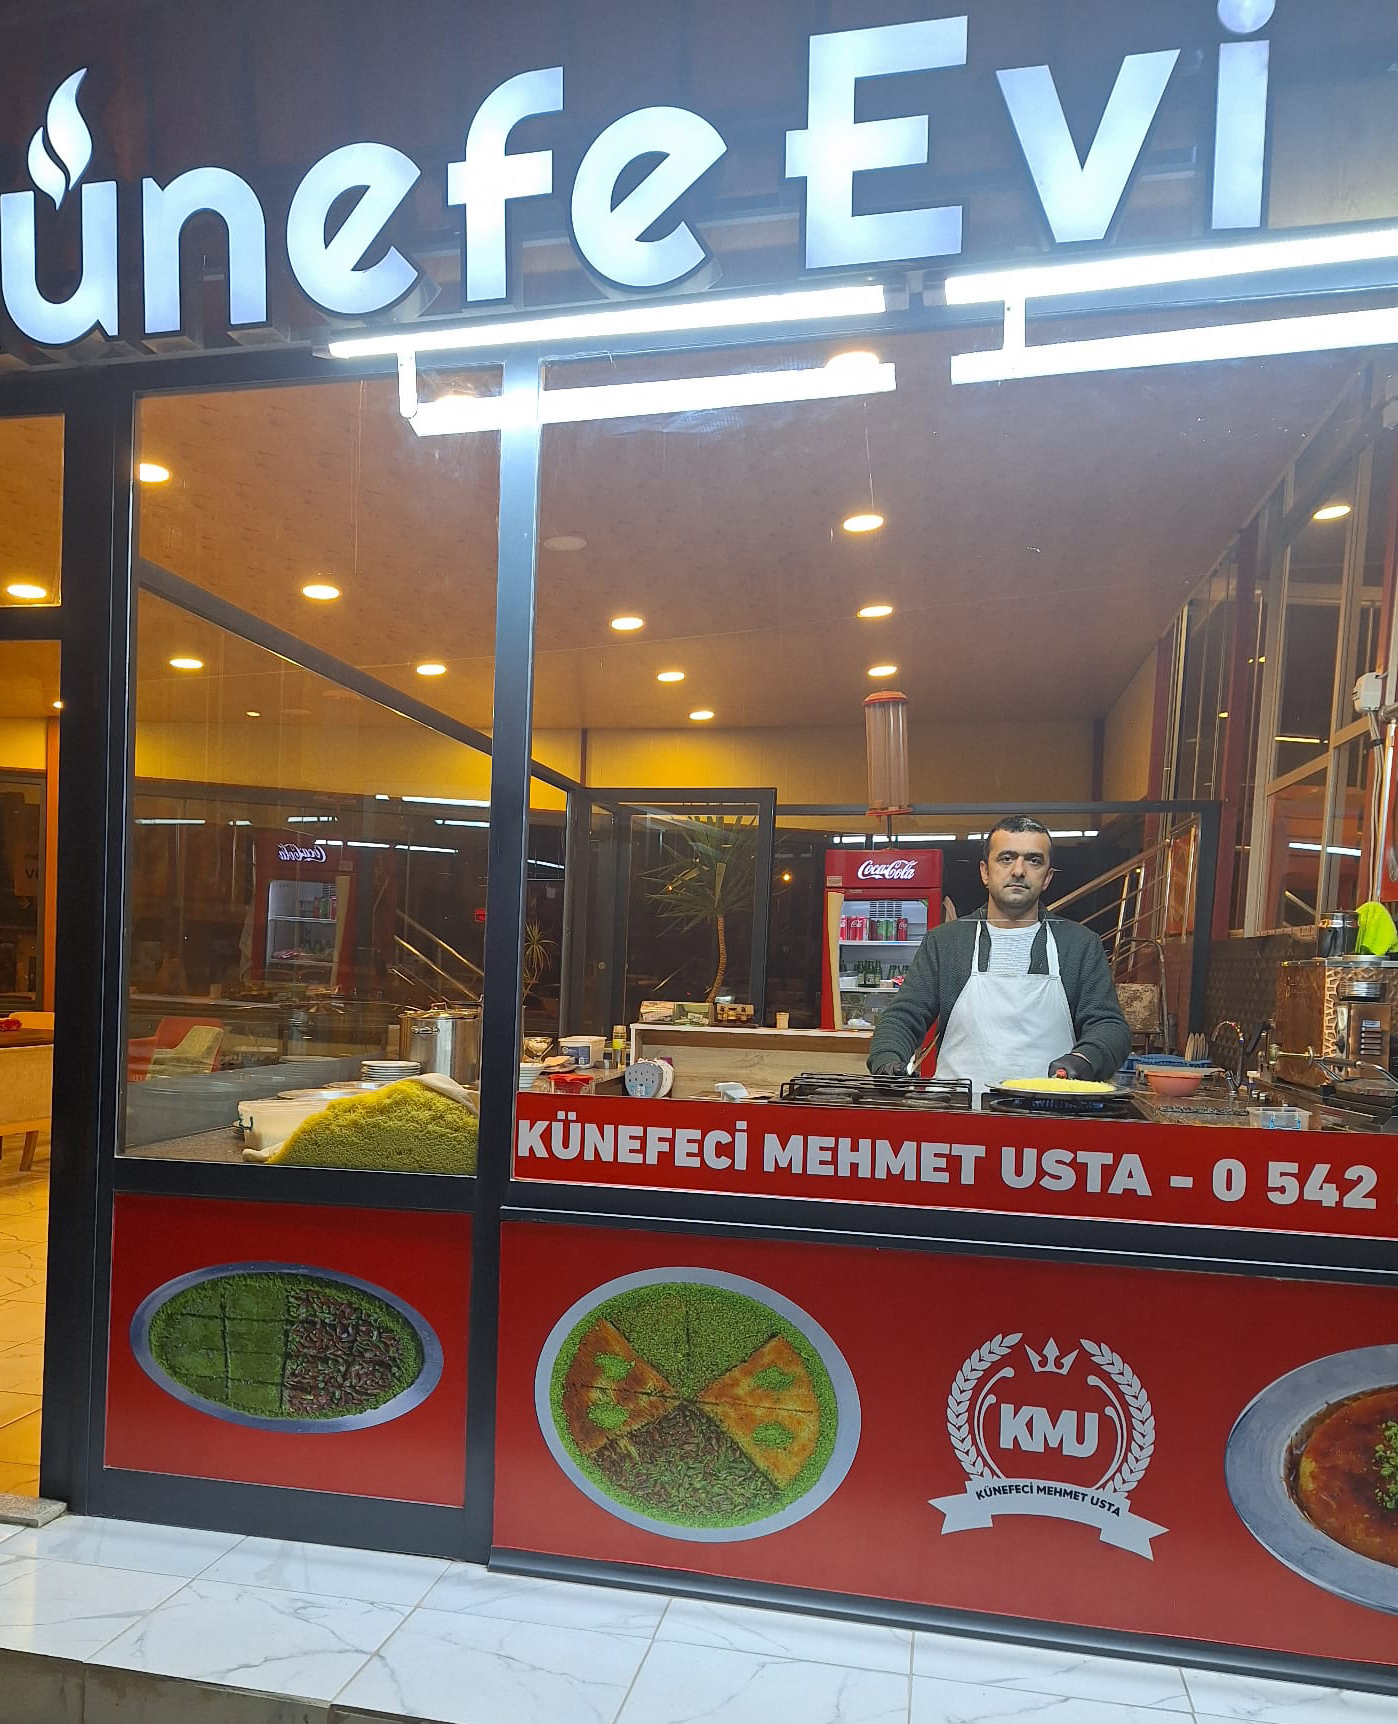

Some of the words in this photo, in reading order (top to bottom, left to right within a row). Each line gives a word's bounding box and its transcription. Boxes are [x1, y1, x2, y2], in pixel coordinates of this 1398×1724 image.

[785, 0, 1276, 269] Evi
[857, 860, 918, 879] Coca-Cola
[517, 1111, 748, 1170] KÜNEFECİ
[763, 1133, 986, 1185] MEHMET
[1000, 1146, 1152, 1197] USTA
[1169, 1175, 1194, 1188] -
[1212, 1158, 1247, 1202] 0
[1266, 1161, 1378, 1210] 542
[1000, 1403, 1099, 1458] KMU
[975, 1482, 1034, 1501] KÜNEFECİ
[1036, 1484, 1088, 1503] MEHMET
[1090, 1495, 1121, 1517] USTA
